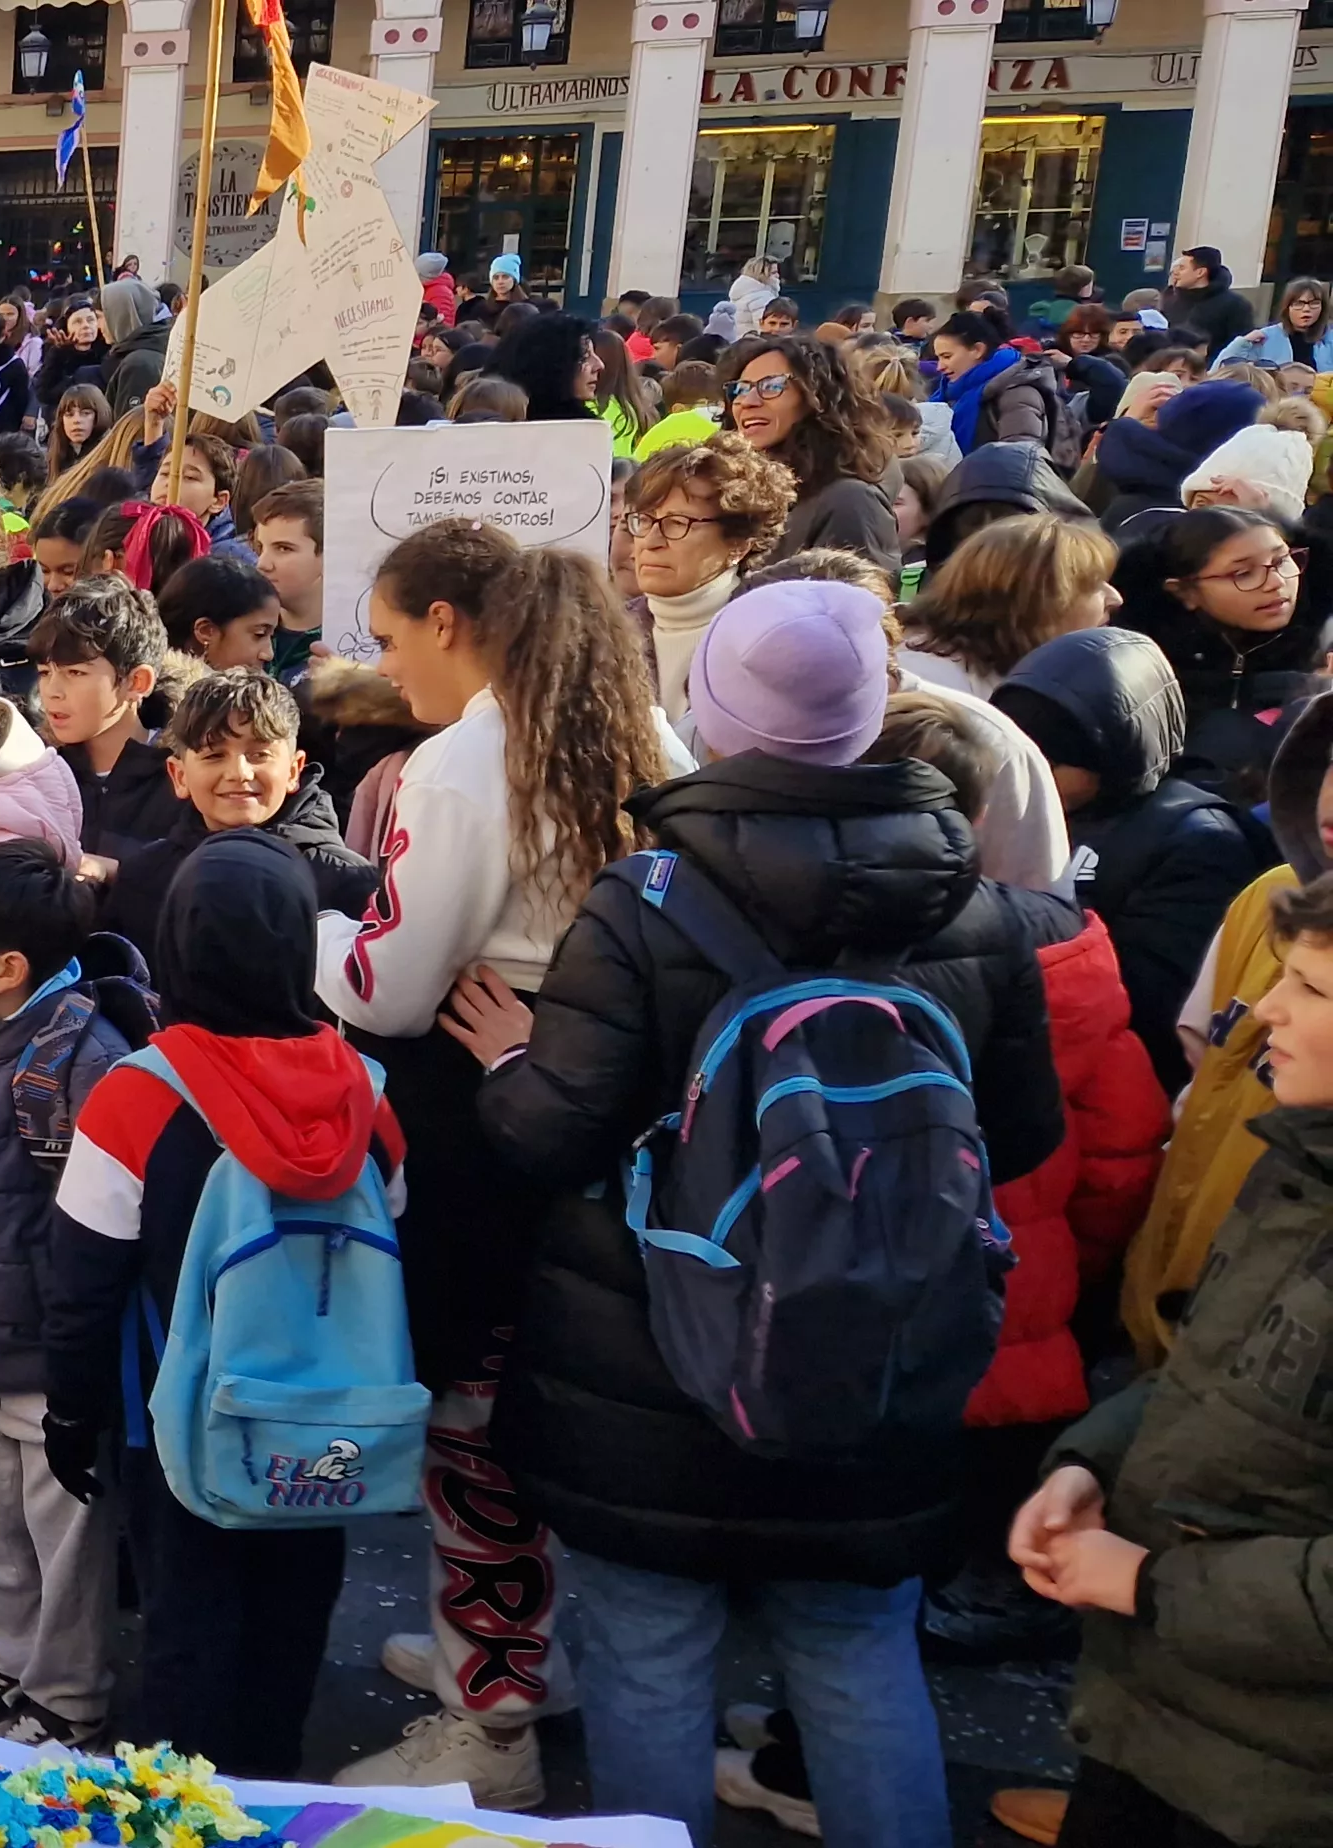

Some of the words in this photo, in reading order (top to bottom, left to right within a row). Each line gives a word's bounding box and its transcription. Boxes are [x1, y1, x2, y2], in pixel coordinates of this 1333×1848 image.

[489, 76, 630, 112] ULTRAMARINOS
[702, 69, 757, 104] LA
[219, 168, 237, 193] LA
[334, 296, 395, 330] NECESITAMOS
[413, 491, 482, 505] DEBEMOS
[493, 491, 548, 505] CONTAR
[265, 1452, 309, 1483] EL
